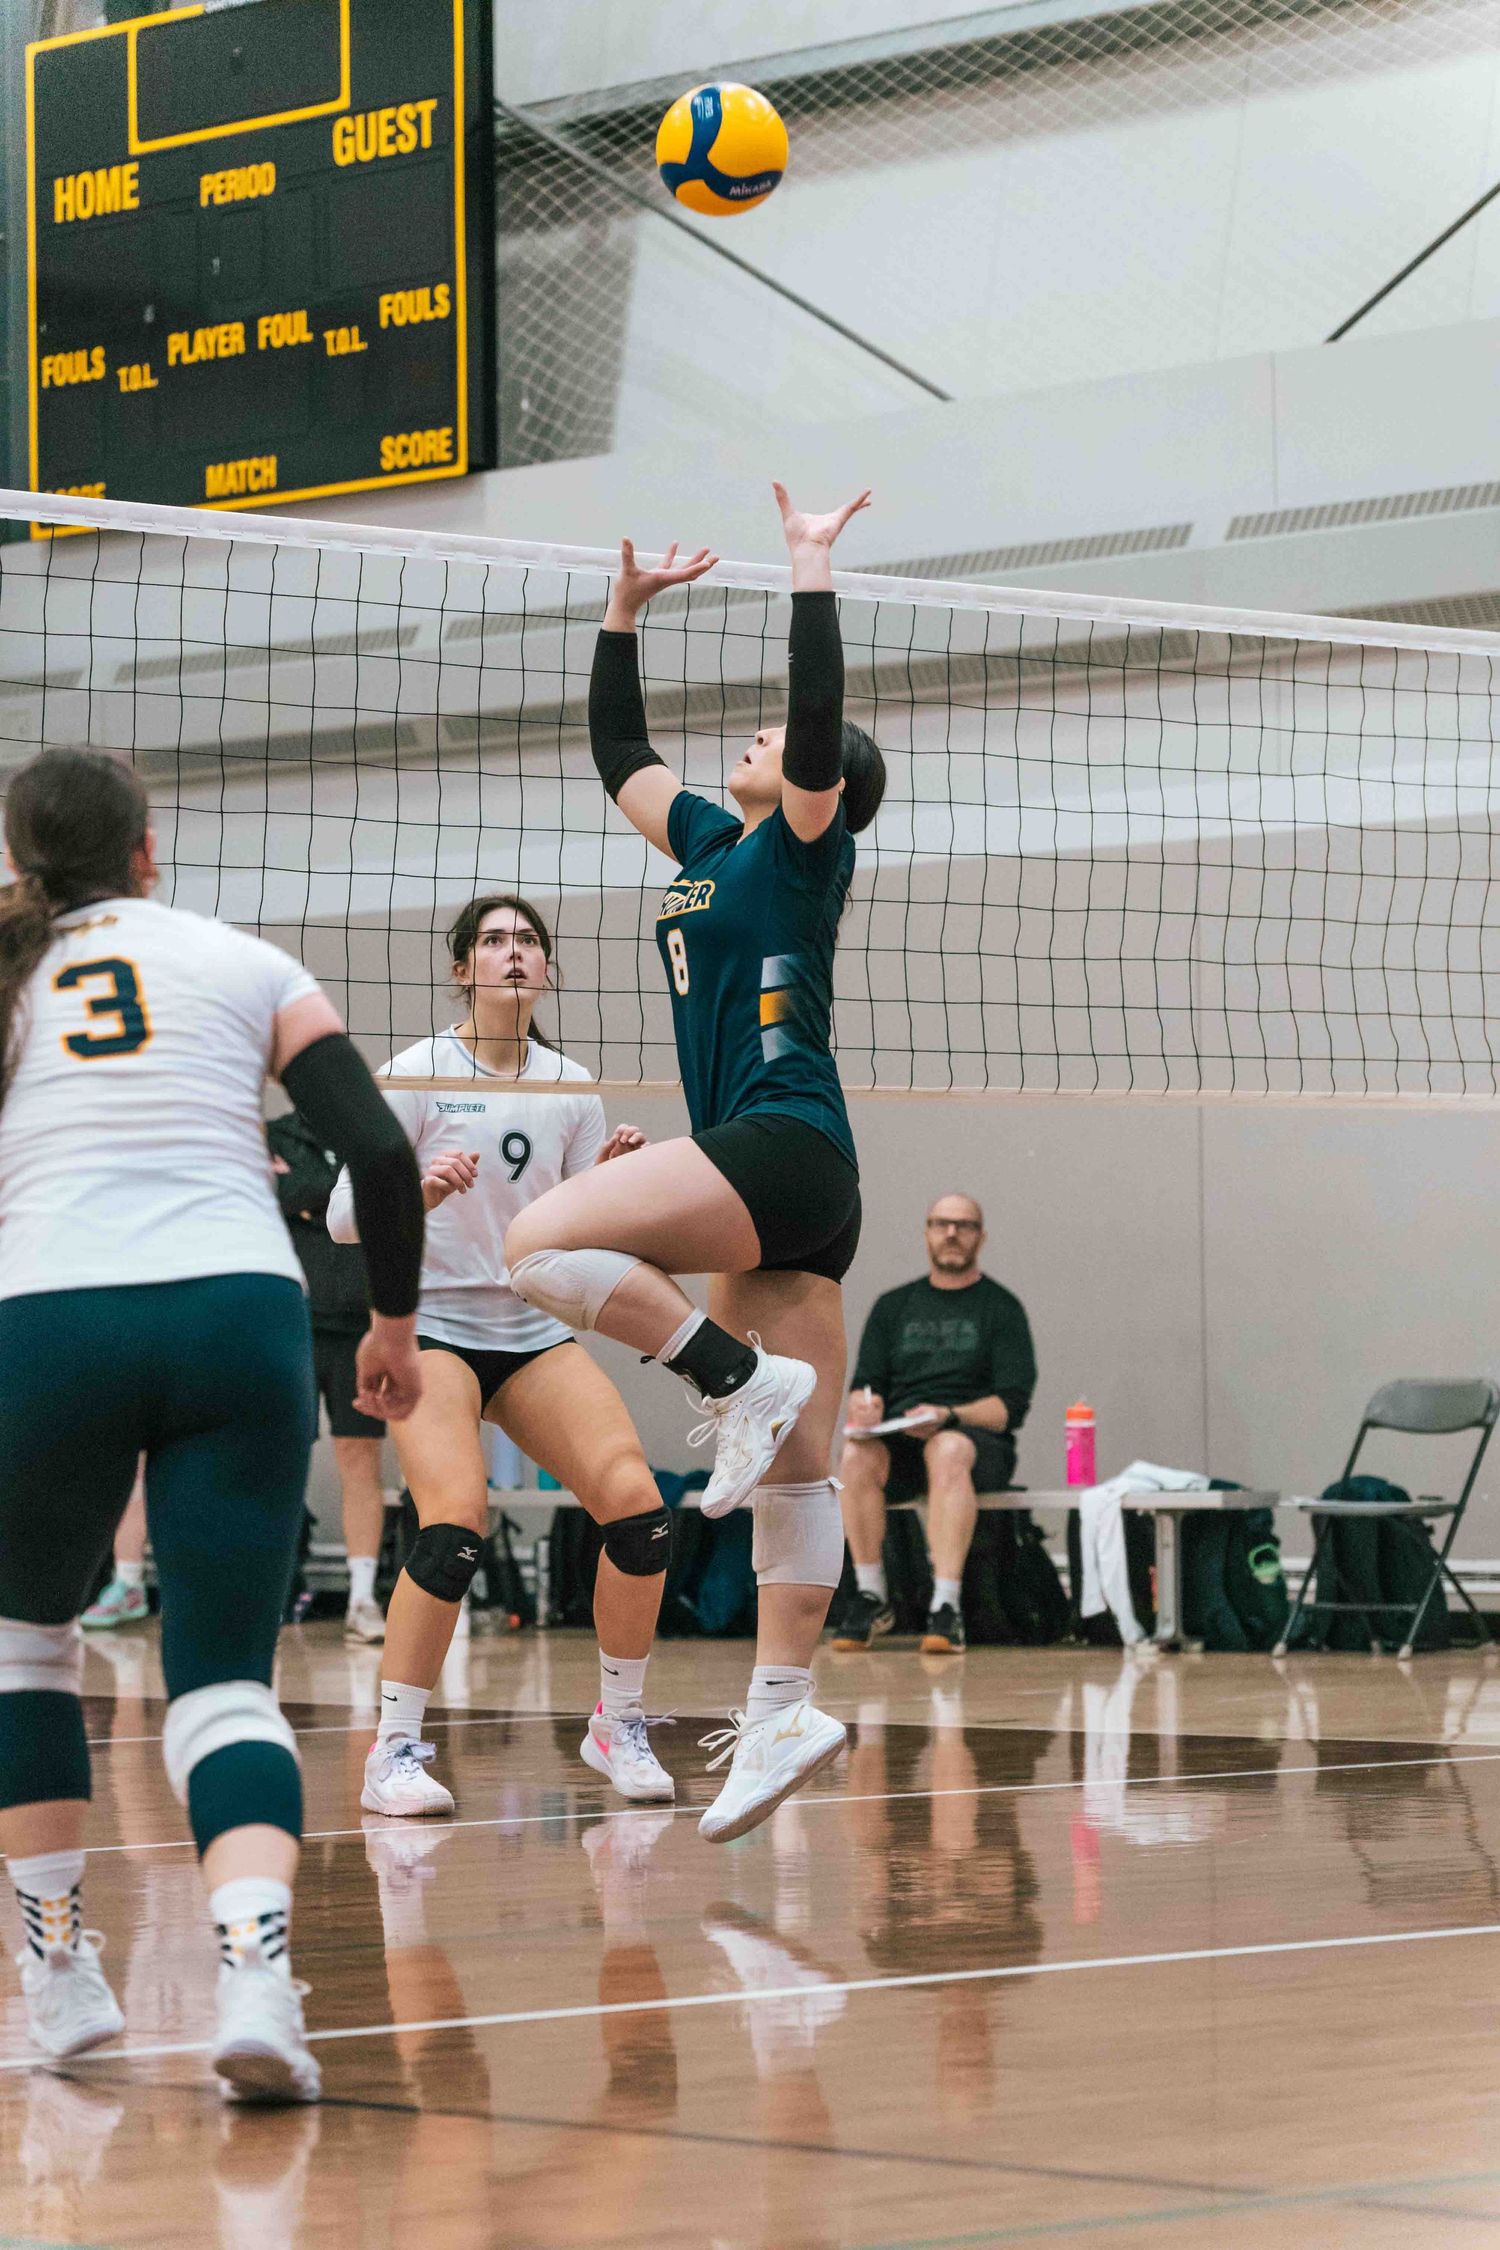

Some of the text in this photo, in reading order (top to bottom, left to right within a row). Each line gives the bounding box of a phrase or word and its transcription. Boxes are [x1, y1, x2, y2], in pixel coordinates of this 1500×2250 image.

[332, 99, 438, 166] GUEST
[54, 162, 140, 223] HOME
[200, 162, 277, 207] PERIOD
[379, 284, 451, 328] FOULS
[168, 310, 314, 366] PLAYER FOUL
[42, 346, 106, 388] FOULS
[380, 427, 453, 470] SCORE
[206, 455, 278, 498] MATCH
[667, 928, 689, 996] 8
[52, 956, 152, 1061] 3
[500, 1129, 533, 1184] 9
